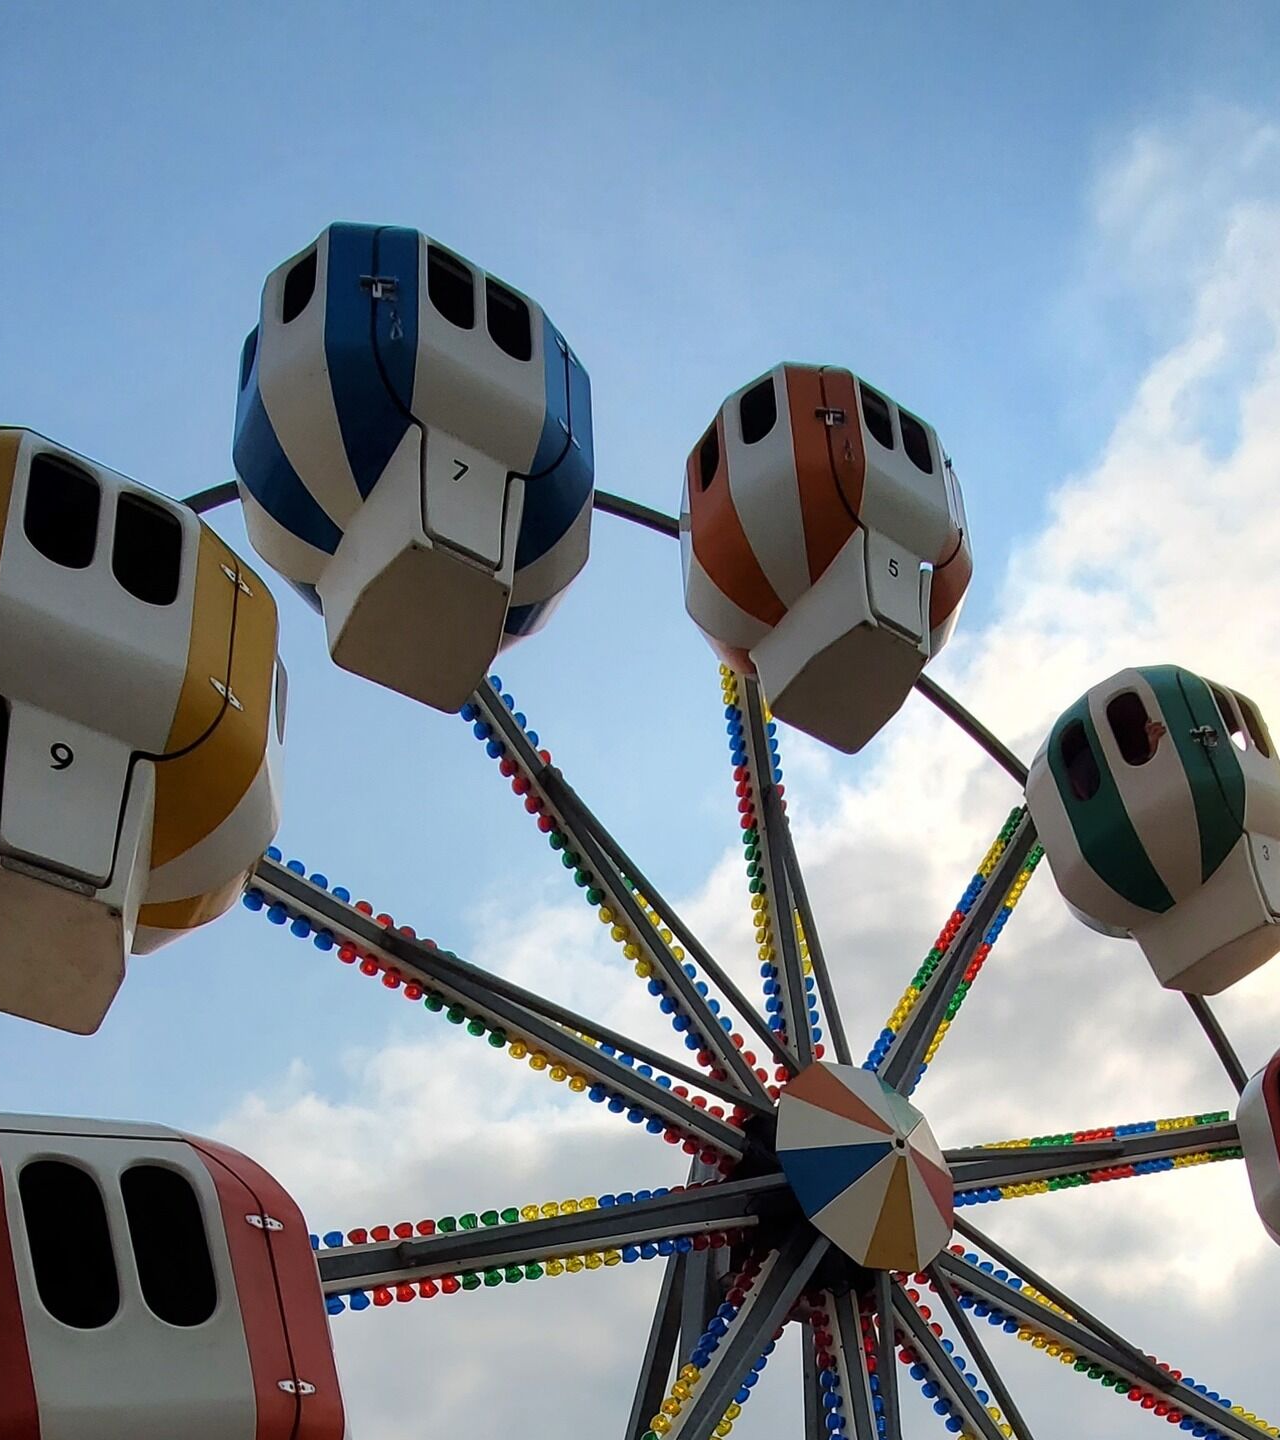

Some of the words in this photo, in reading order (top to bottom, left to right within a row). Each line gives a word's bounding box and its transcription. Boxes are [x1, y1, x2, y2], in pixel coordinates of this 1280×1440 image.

[452, 459, 469, 481] 7
[888, 558, 899, 578] 5
[50, 742, 74, 770] 9
[1262, 844, 1270, 861] 3
